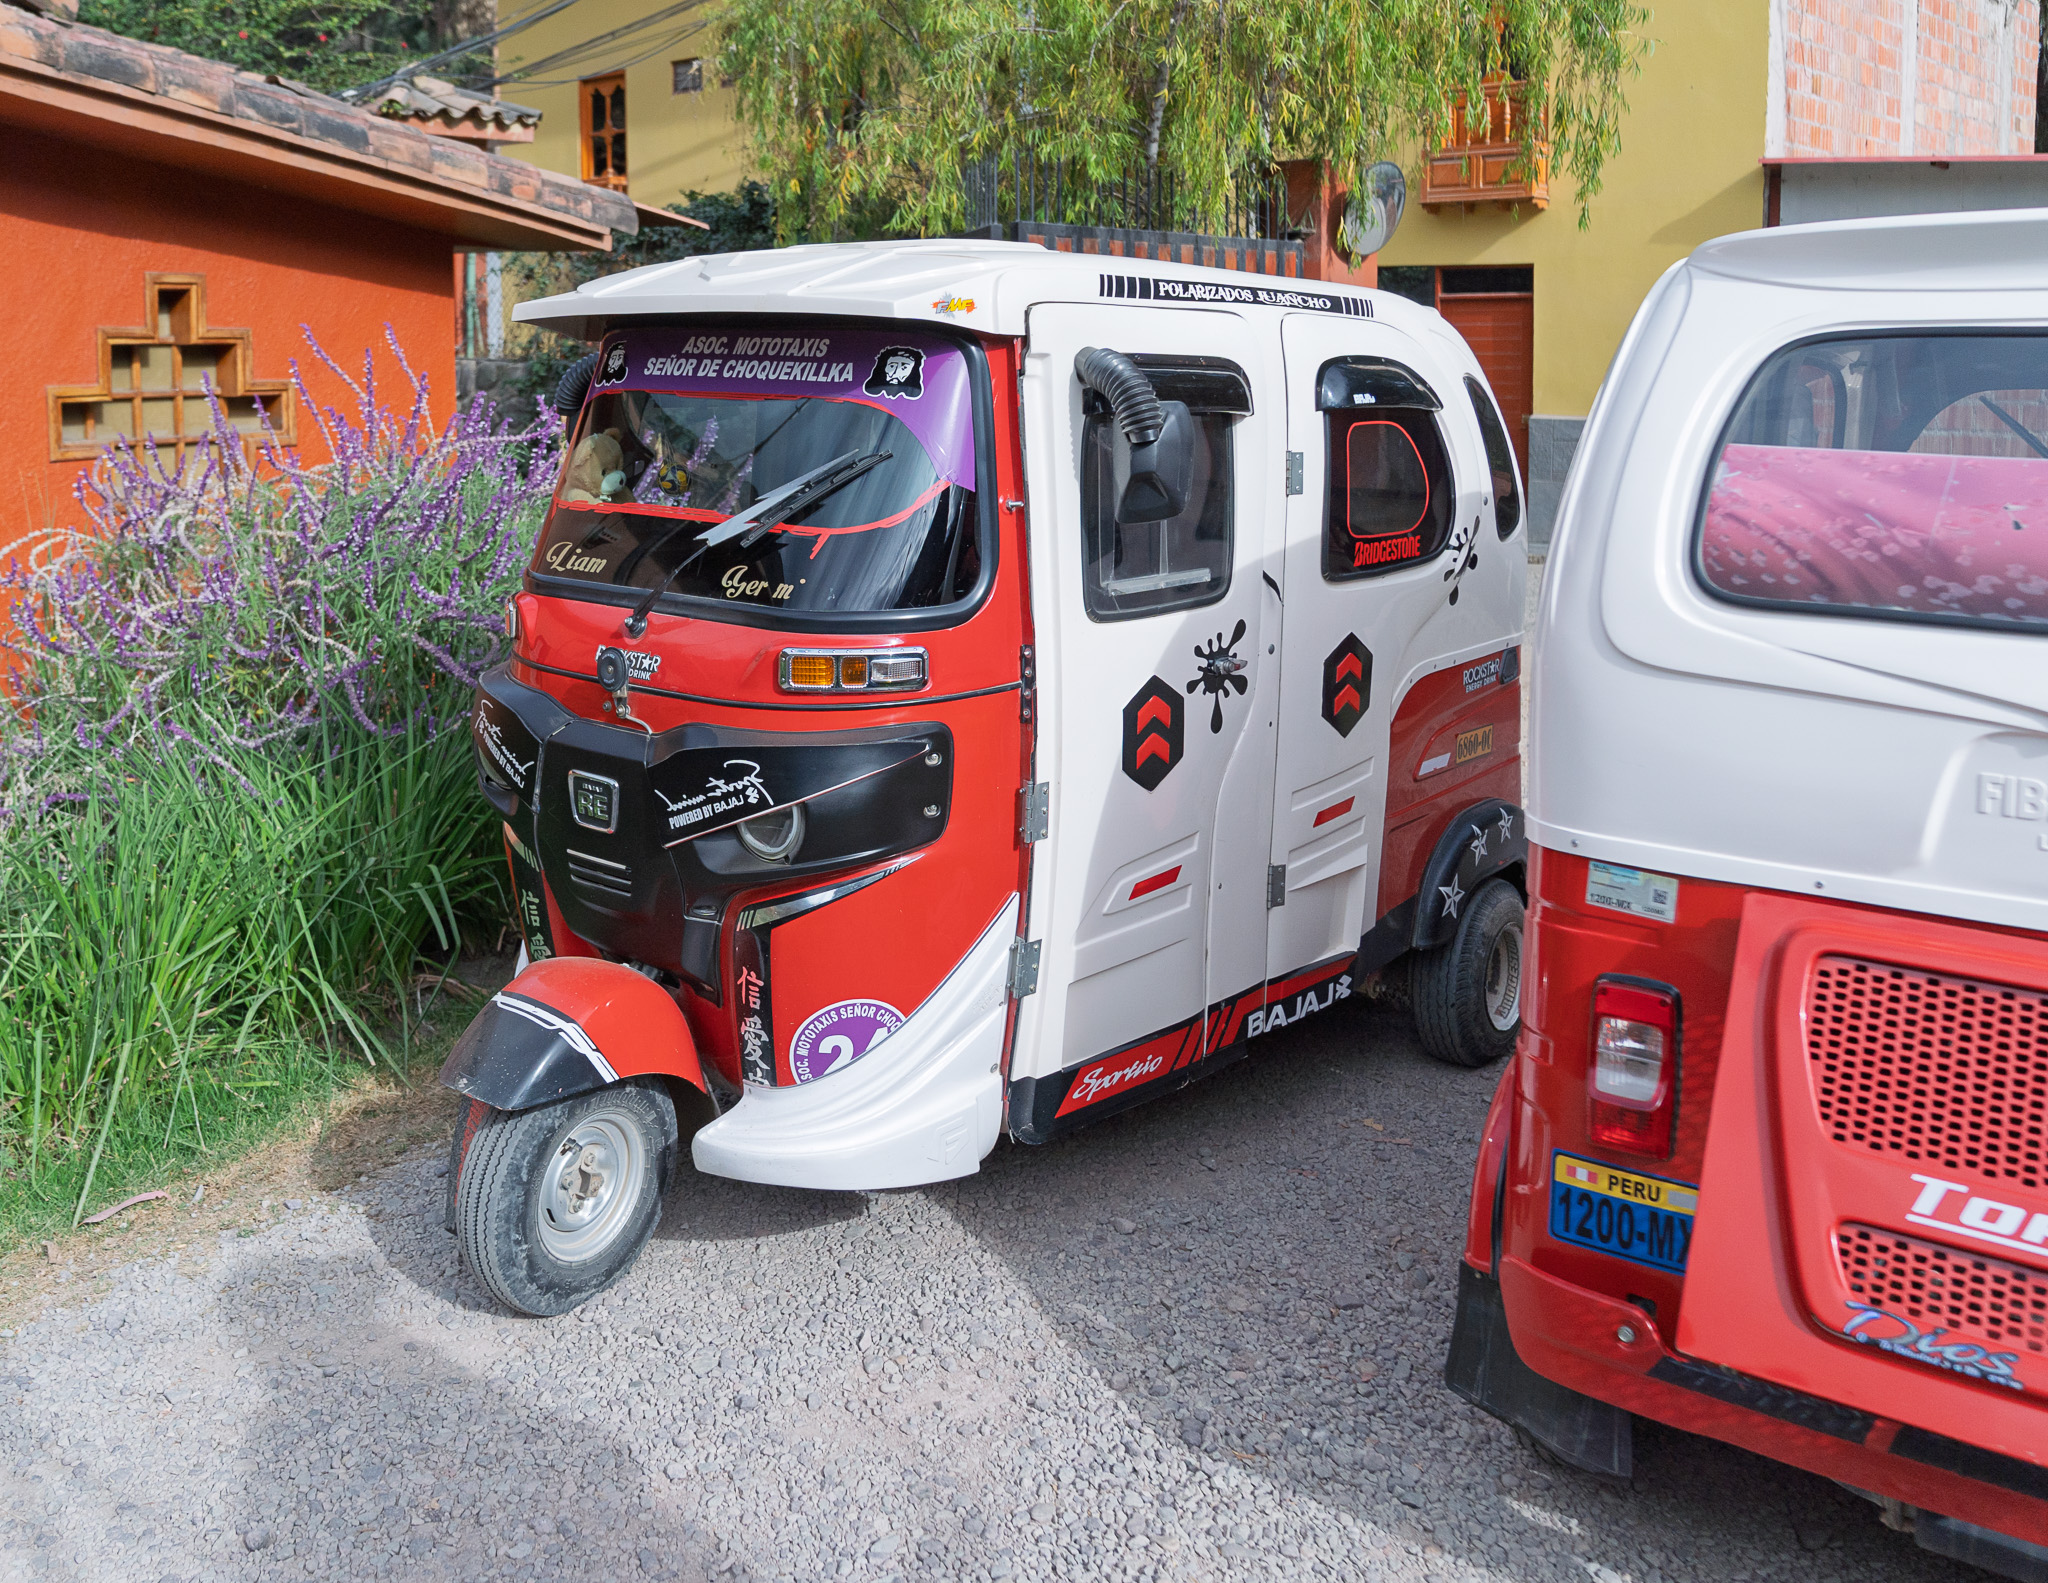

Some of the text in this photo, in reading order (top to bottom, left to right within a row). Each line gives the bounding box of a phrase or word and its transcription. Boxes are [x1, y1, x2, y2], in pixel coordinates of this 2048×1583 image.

[1158, 281, 1253, 303] POLARIZADOS
[682, 336, 831, 358] ASOC. MOTOTAXIS
[643, 355, 854, 383] SEÑOR DE CHOQUEKILLKA
[546, 541, 608, 574] Liam
[1353, 535, 1421, 567] BRIDGESTONE
[628, 668, 652, 681] DRINK
[1465, 674, 1498, 694] ENERGY DRINK
[505, 761, 525, 789] BAJAJ
[578, 790, 609, 820] RE
[668, 794, 745, 830] POWERED BY BAJAJ
[840, 1003, 877, 1019] SEÑOR
[1247, 982, 1336, 1039] BAJAJ
[796, 1010, 839, 1057] MOTOTAXIS
[796, 1058, 813, 1081] SOC.
[1607, 1173, 1661, 1203] PERU
[1844, 1300, 2019, 1377] Dios
